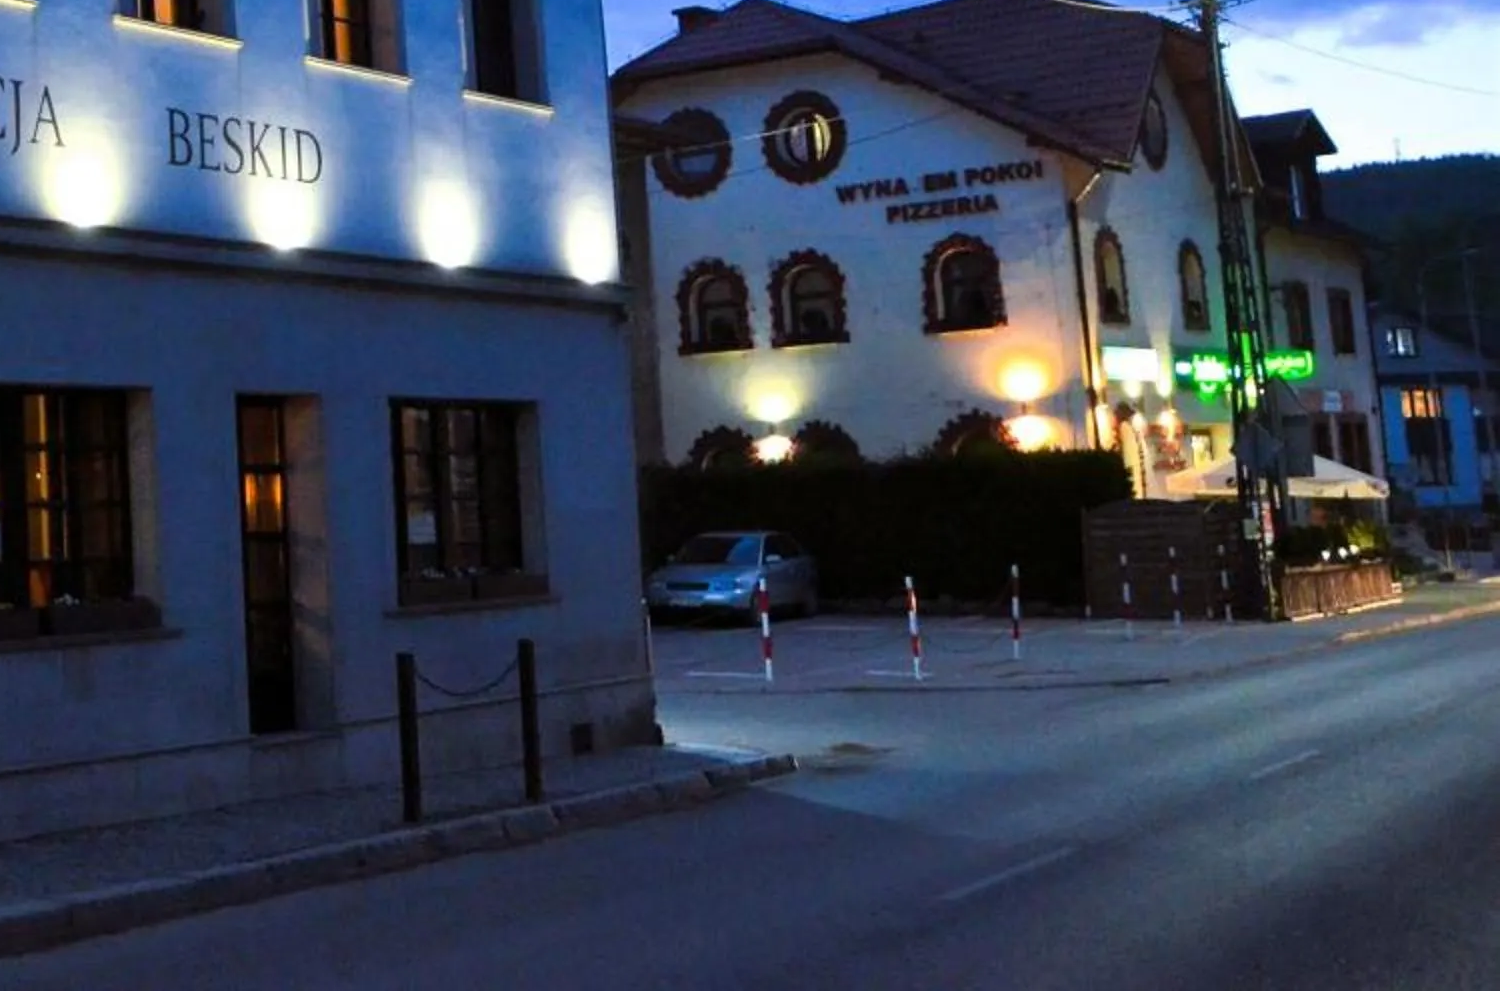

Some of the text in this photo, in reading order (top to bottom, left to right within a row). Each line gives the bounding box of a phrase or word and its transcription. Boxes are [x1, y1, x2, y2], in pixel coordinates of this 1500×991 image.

[165, 107, 325, 185] BESKID
[964, 160, 1044, 187] POKOI
[885, 194, 999, 225] PIZZERIA
